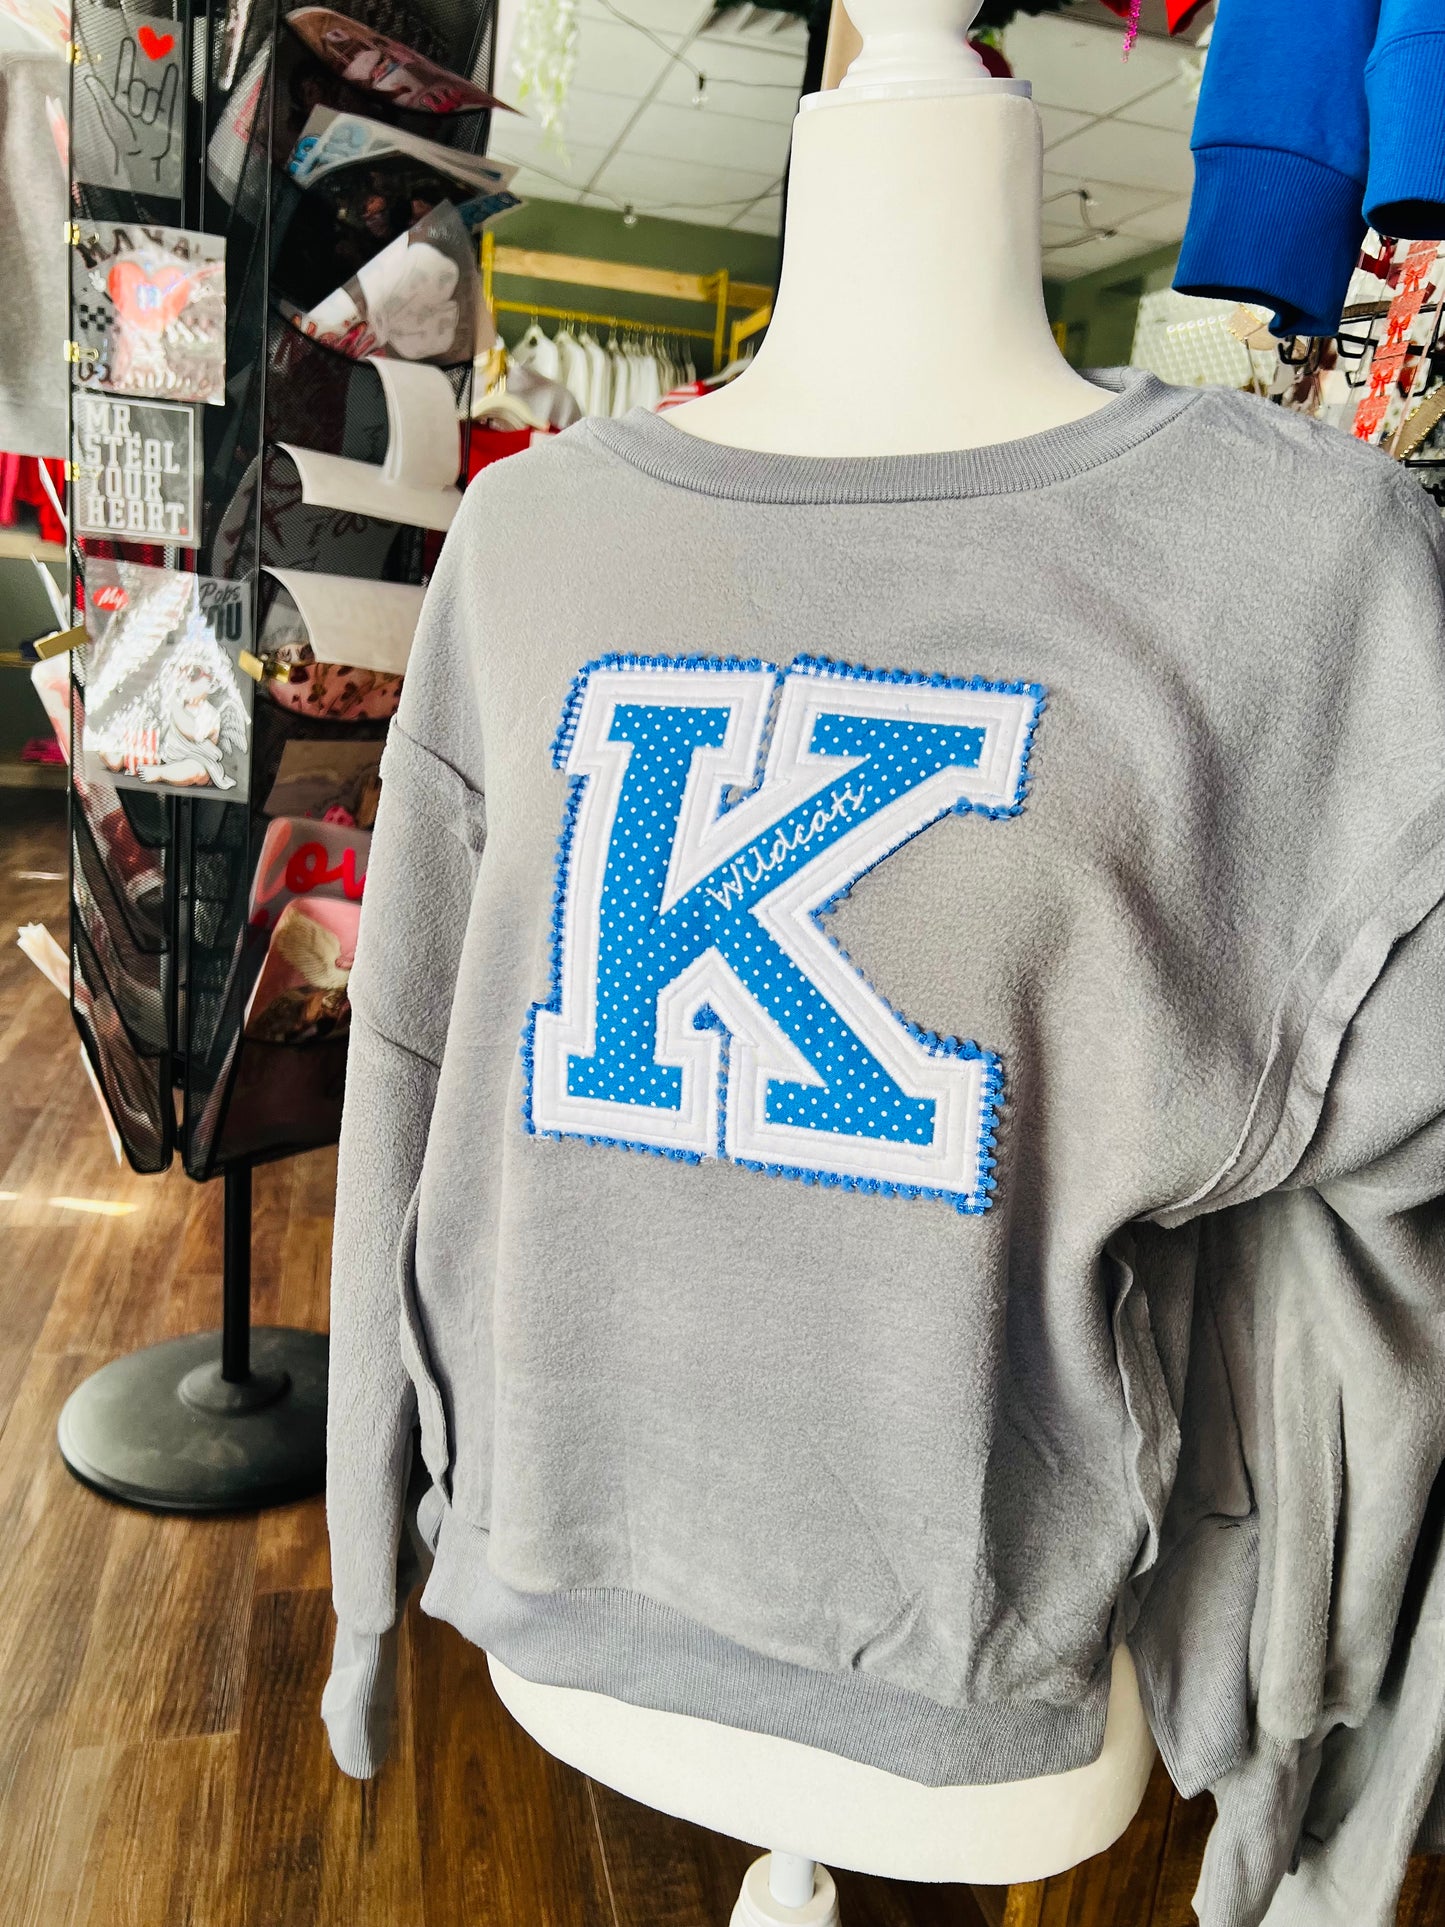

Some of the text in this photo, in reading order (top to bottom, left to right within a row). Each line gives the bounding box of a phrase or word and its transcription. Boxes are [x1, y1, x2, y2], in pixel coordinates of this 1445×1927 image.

[83, 432, 181, 474] STEAL
[83, 462, 163, 504] YOUR
[704, 784, 867, 911] Wildcats
[530, 668, 1036, 1200] K
